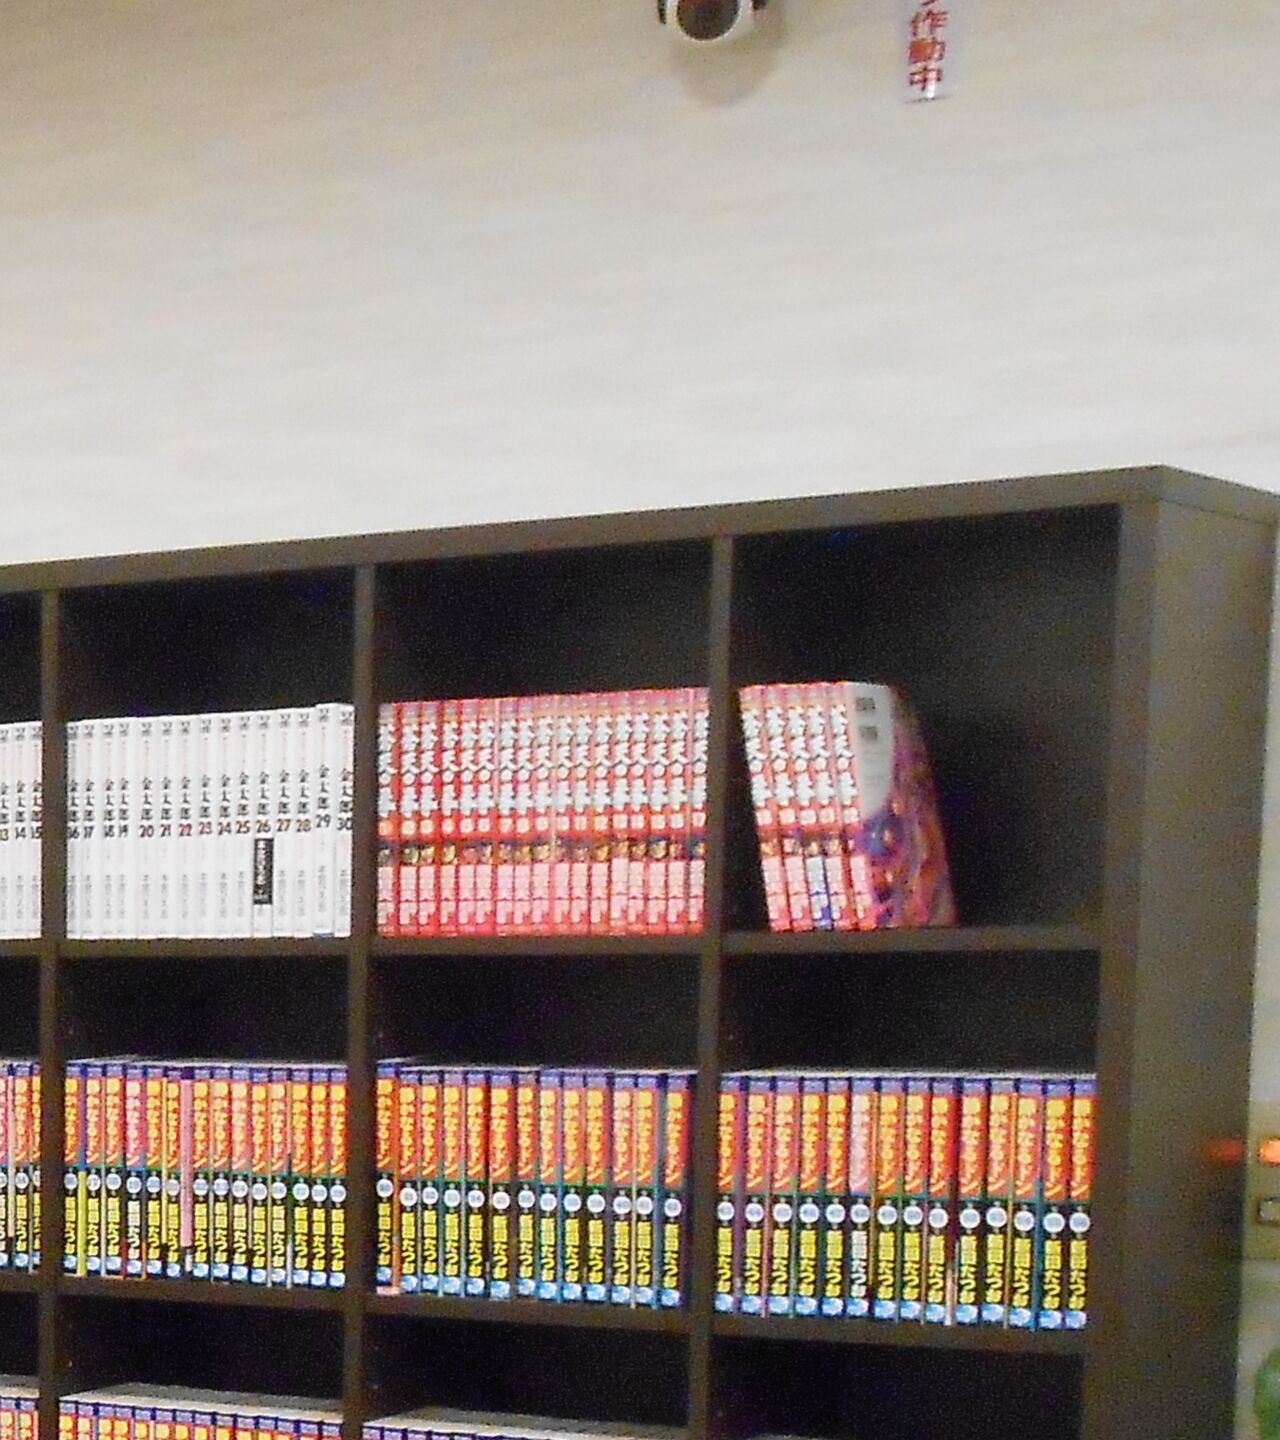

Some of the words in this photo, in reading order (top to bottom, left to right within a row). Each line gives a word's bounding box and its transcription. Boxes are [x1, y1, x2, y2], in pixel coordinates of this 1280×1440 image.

[908, 0, 948, 91] 作動中
[236, 820, 249, 833] 25
[256, 820, 271, 832] 26
[277, 819, 291, 831] 27
[296, 819, 311, 832] 28
[316, 815, 330, 828] 29
[0, 828, 9, 840] 13
[15, 827, 26, 839] 14
[31, 826, 41, 839] 15
[84, 826, 94, 838] 17
[140, 825, 154, 837] 20
[179, 823, 192, 836] 22
[199, 822, 212, 834] 23
[218, 823, 232, 835] 24
